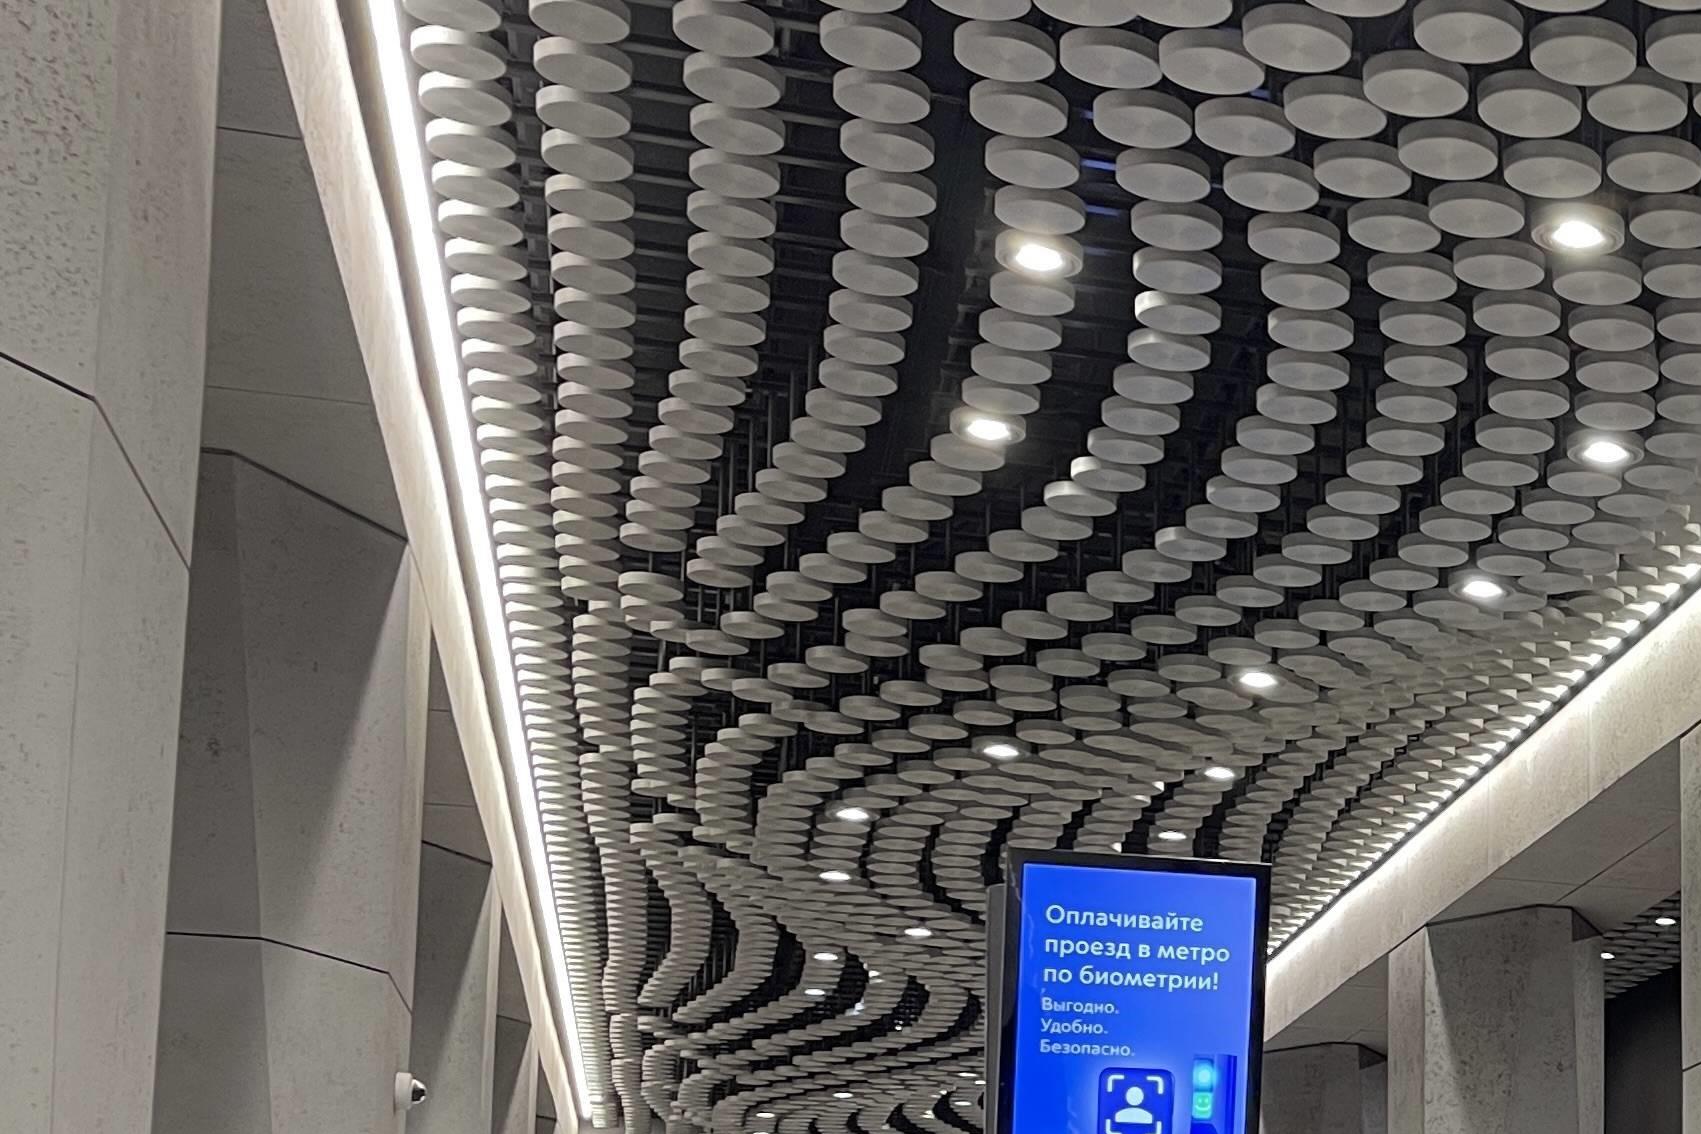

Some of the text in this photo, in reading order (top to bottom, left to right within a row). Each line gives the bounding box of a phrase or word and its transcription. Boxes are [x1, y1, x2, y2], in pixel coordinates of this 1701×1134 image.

[1045, 904, 1203, 932] Оплачивайте
[1044, 938, 1230, 966] проезд в метро
[1043, 965, 1219, 992] по биометрии!
[1041, 997, 1120, 1015] Выгодно.
[1040, 1018, 1109, 1035] Удобно.
[1039, 1039, 1135, 1057] Безопасно.
